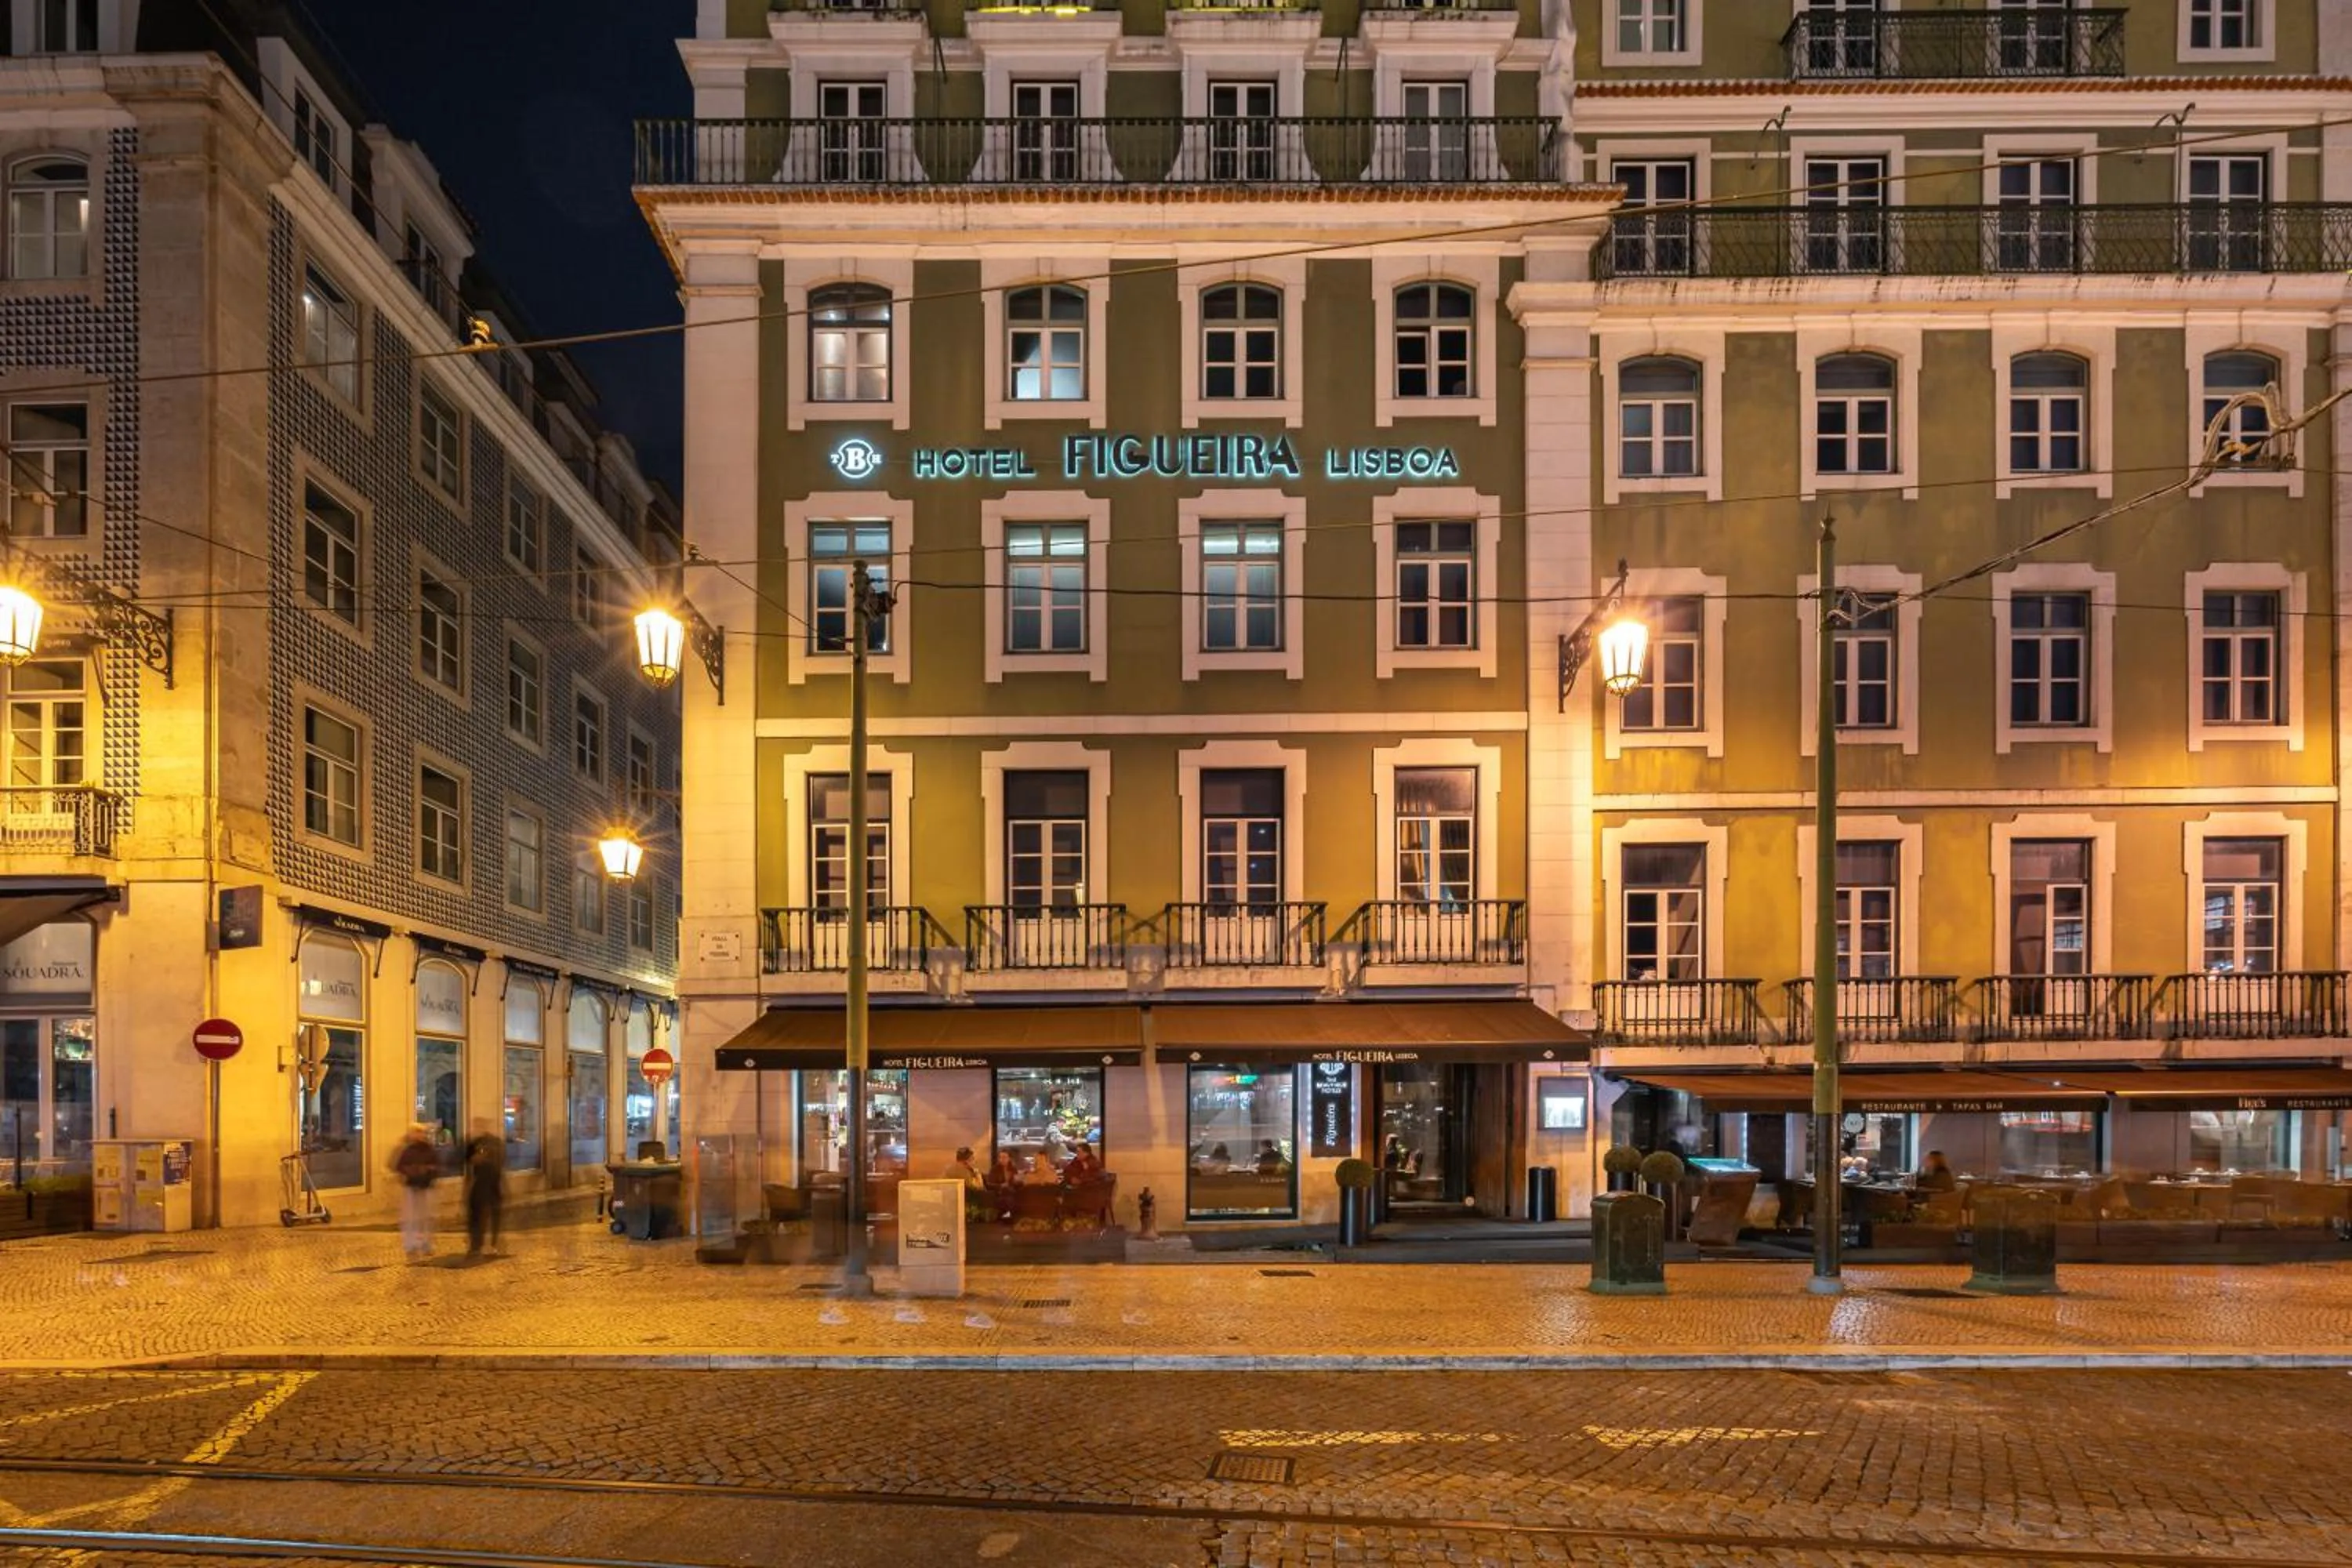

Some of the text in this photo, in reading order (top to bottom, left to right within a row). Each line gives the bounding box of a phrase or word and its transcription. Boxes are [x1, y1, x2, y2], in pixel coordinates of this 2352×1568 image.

[914, 434, 1459, 478] HOTEL FIGUEIRA LISBOA
[906, 1056, 964, 1068] FIGUEIRA
[1335, 1050, 1395, 1062] FIGUEIRA
[1861, 1102, 1926, 1111] RESTAURANTE
